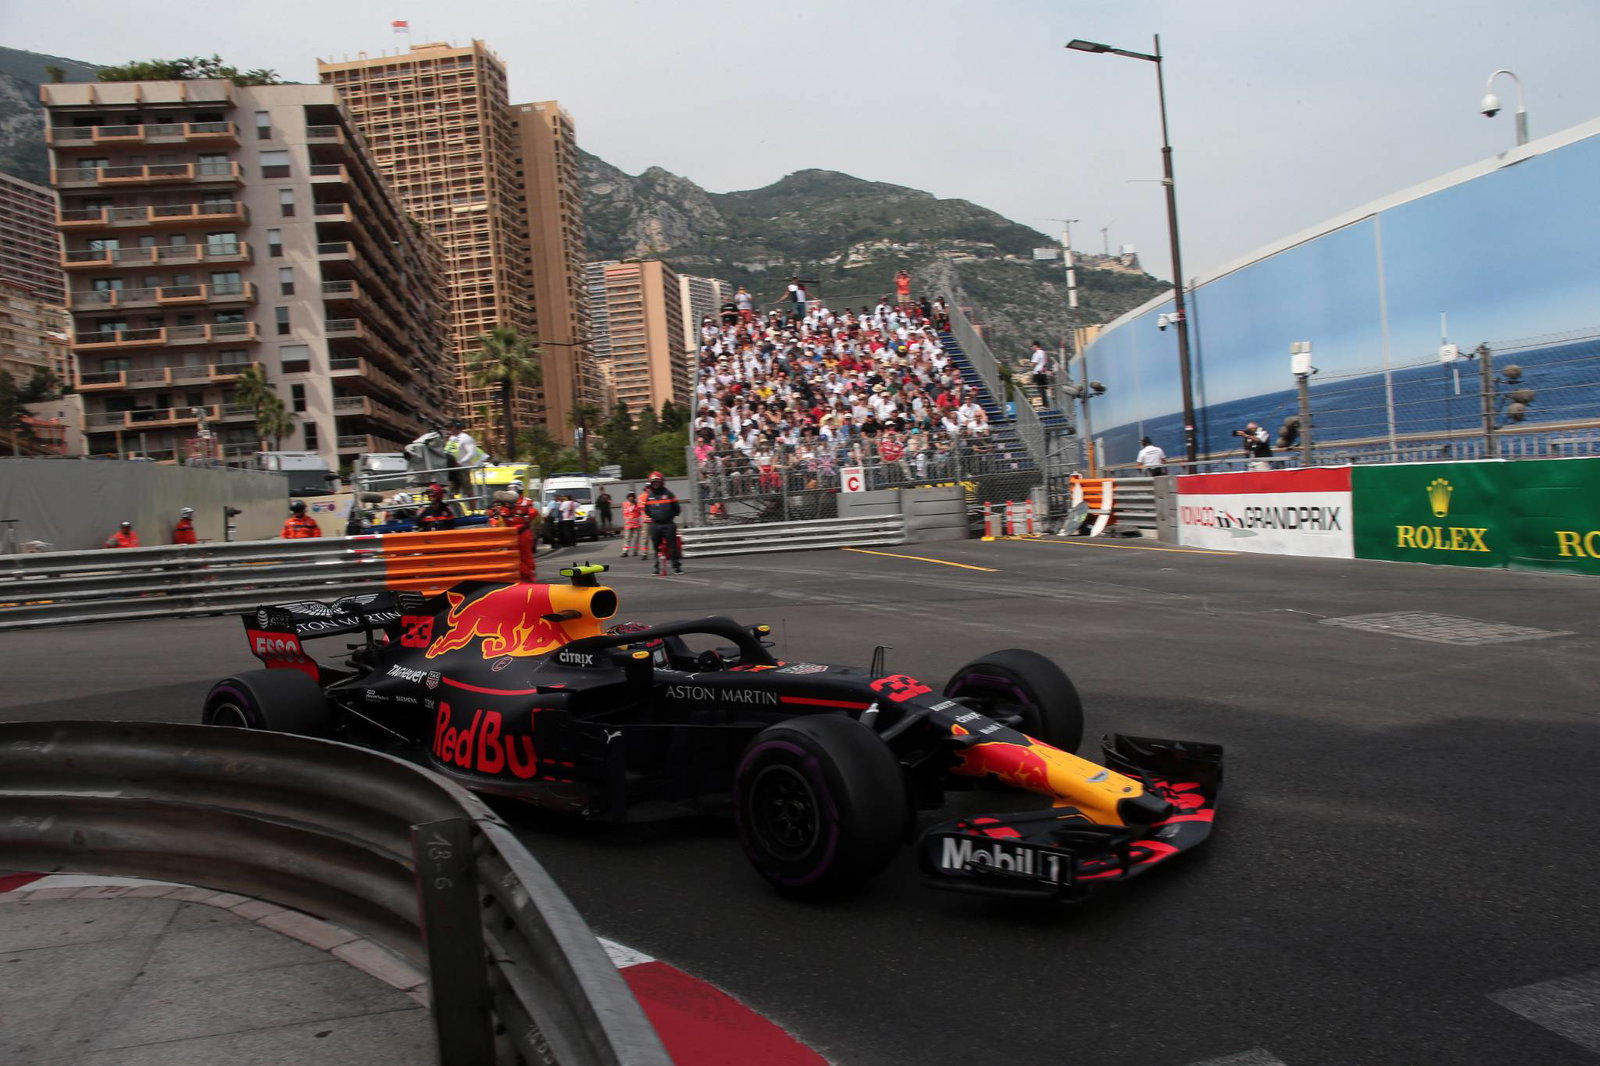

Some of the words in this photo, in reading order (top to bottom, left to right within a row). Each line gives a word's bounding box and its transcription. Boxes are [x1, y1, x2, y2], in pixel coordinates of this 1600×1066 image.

[1396, 524, 1491, 553] ROLEX
[665, 685, 716, 701] ASTON
[721, 688, 778, 705] MARTIN
[941, 837, 1034, 875] Mobil
[1047, 855, 1060, 882] 1
